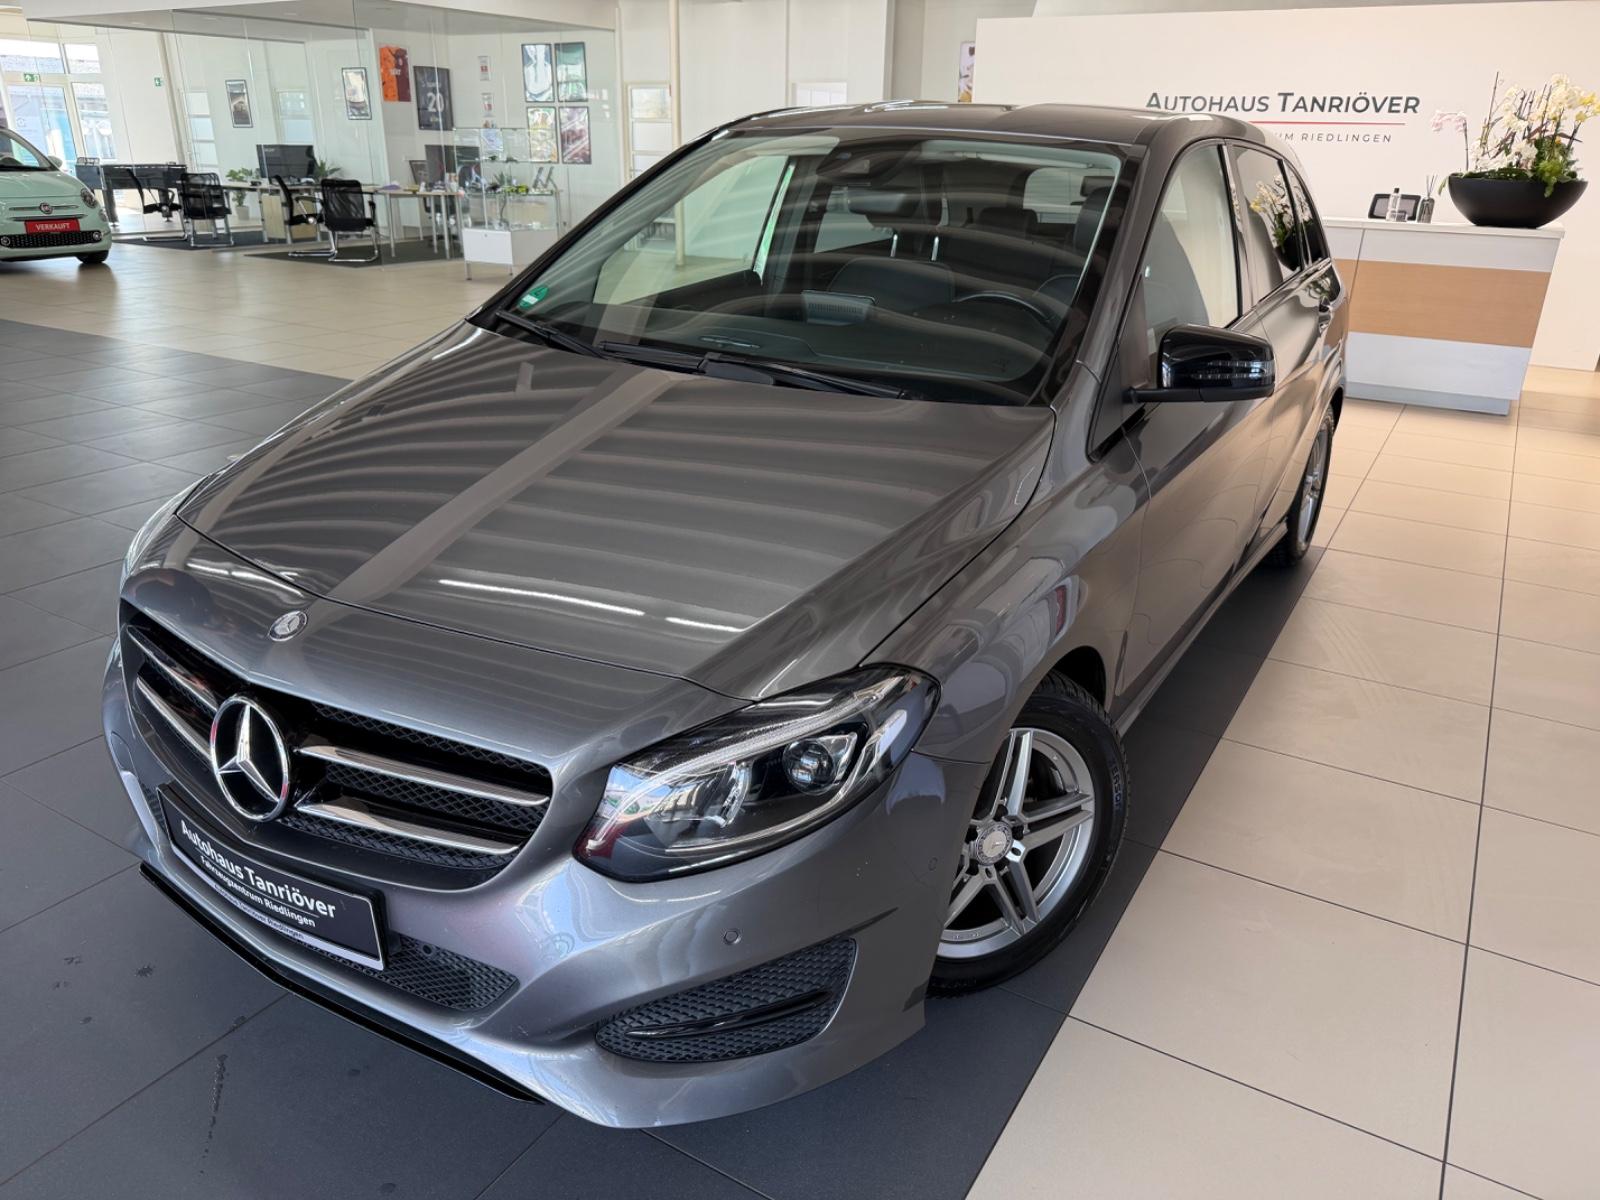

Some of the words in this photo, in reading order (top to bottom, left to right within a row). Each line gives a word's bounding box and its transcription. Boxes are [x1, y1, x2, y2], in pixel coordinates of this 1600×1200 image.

[427, 92, 444, 113] 20
[1146, 92, 1270, 113] AUTOHAUS
[1278, 91, 1421, 114] TANRIÖVER
[1301, 132, 1392, 143] RIEDLINGEN
[36, 222, 71, 231] VERKAUFT
[180, 819, 245, 880] Autohaus
[244, 866, 336, 919] Tanriöver
[264, 897, 316, 928] Riedlingen
